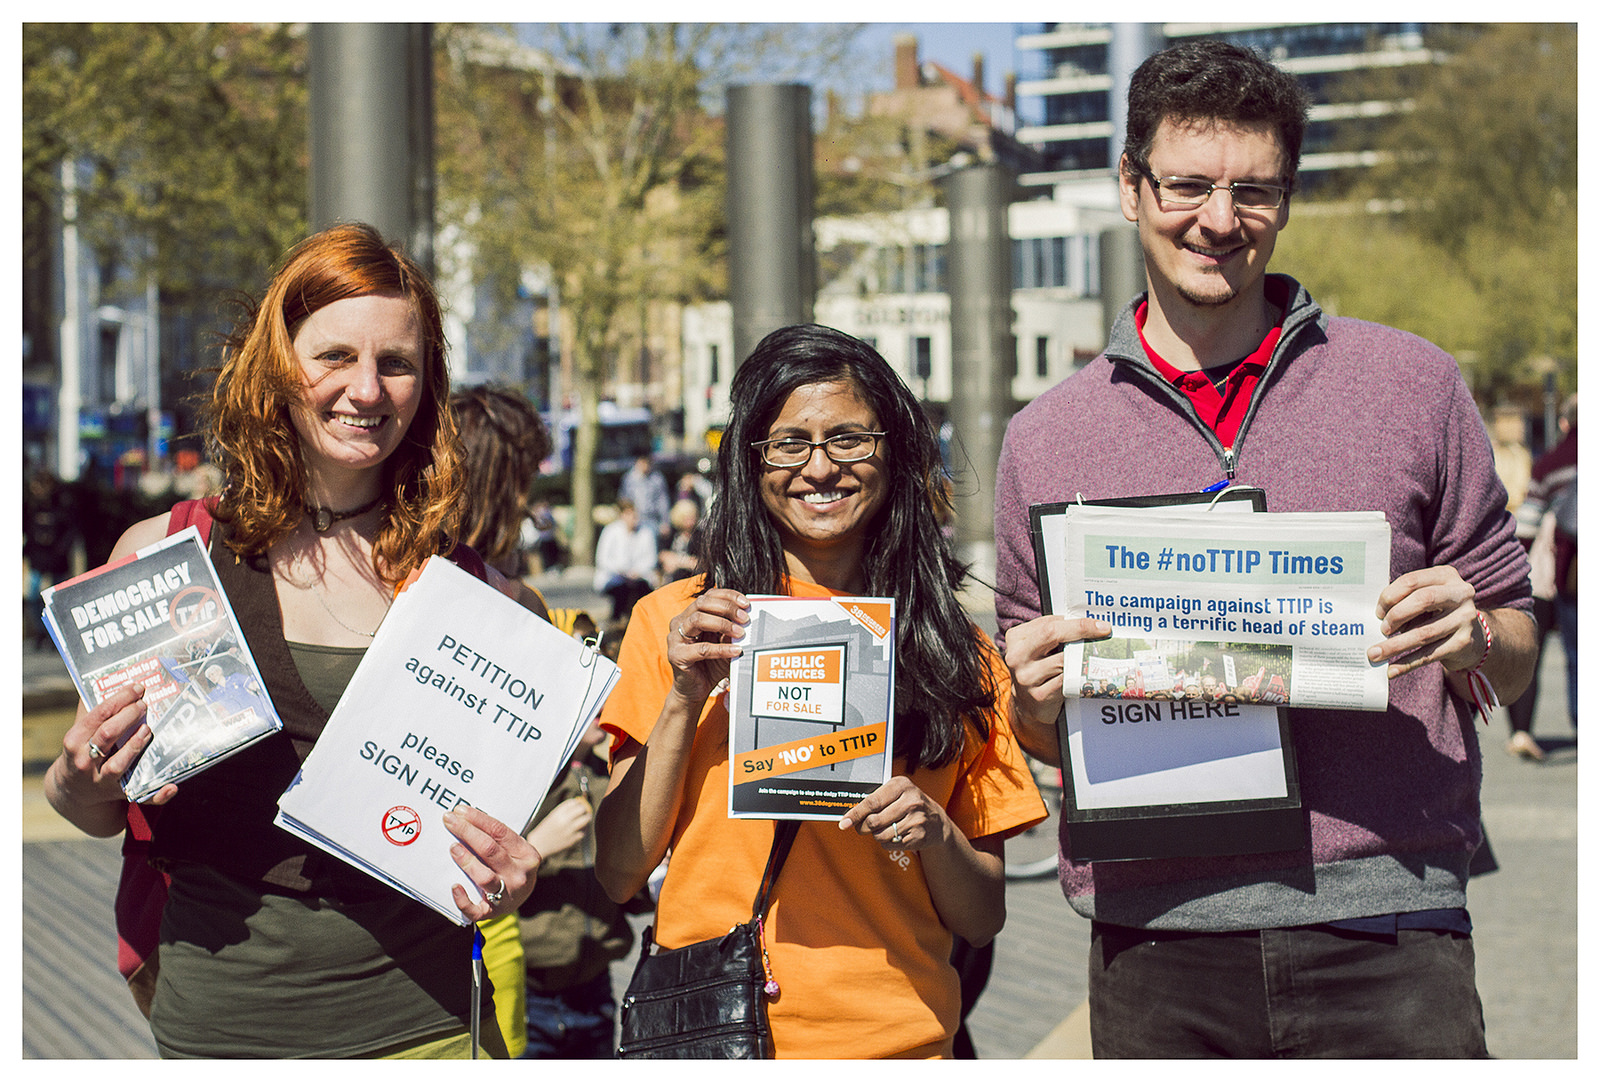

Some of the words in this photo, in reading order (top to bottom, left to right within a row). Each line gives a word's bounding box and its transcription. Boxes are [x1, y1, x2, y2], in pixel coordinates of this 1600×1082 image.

[1105, 545, 1149, 570] The
[1157, 547, 1261, 574] #noTTIP
[1268, 550, 1344, 575] Times
[70, 561, 193, 630] DEMOCRACY
[1085, 590, 1115, 607] The
[1119, 594, 1202, 615] campaign
[1207, 597, 1271, 616] against
[1276, 598, 1313, 614] TTIP
[1318, 598, 1333, 614] is
[175, 600, 217, 626] TTIP
[850, 605, 864, 618] 38
[80, 622, 124, 654] FOR
[120, 599, 171, 637] SALE
[1158, 616, 1167, 629] a
[1172, 614, 1237, 632] terrific
[1242, 619, 1282, 635] head
[1288, 620, 1305, 636] of
[1311, 622, 1364, 636] steam
[437, 634, 545, 711] PETITION
[769, 669, 826, 680] SERVICES
[770, 655, 825, 669] PUBLIC
[405, 656, 488, 715] against
[492, 704, 542, 743] TTIP
[778, 686, 812, 701] NOT
[766, 701, 789, 712] FOR
[793, 703, 822, 714] SALE
[1101, 702, 1162, 725] SIGN
[1170, 702, 1240, 721] HERE
[400, 731, 475, 784] please
[743, 757, 774, 773] Say
[819, 743, 836, 757] to
[839, 732, 878, 752] TTIP
[360, 741, 420, 787] SIGN
[420, 778, 488, 815] HE
[777, 788, 799, 796] campaign
